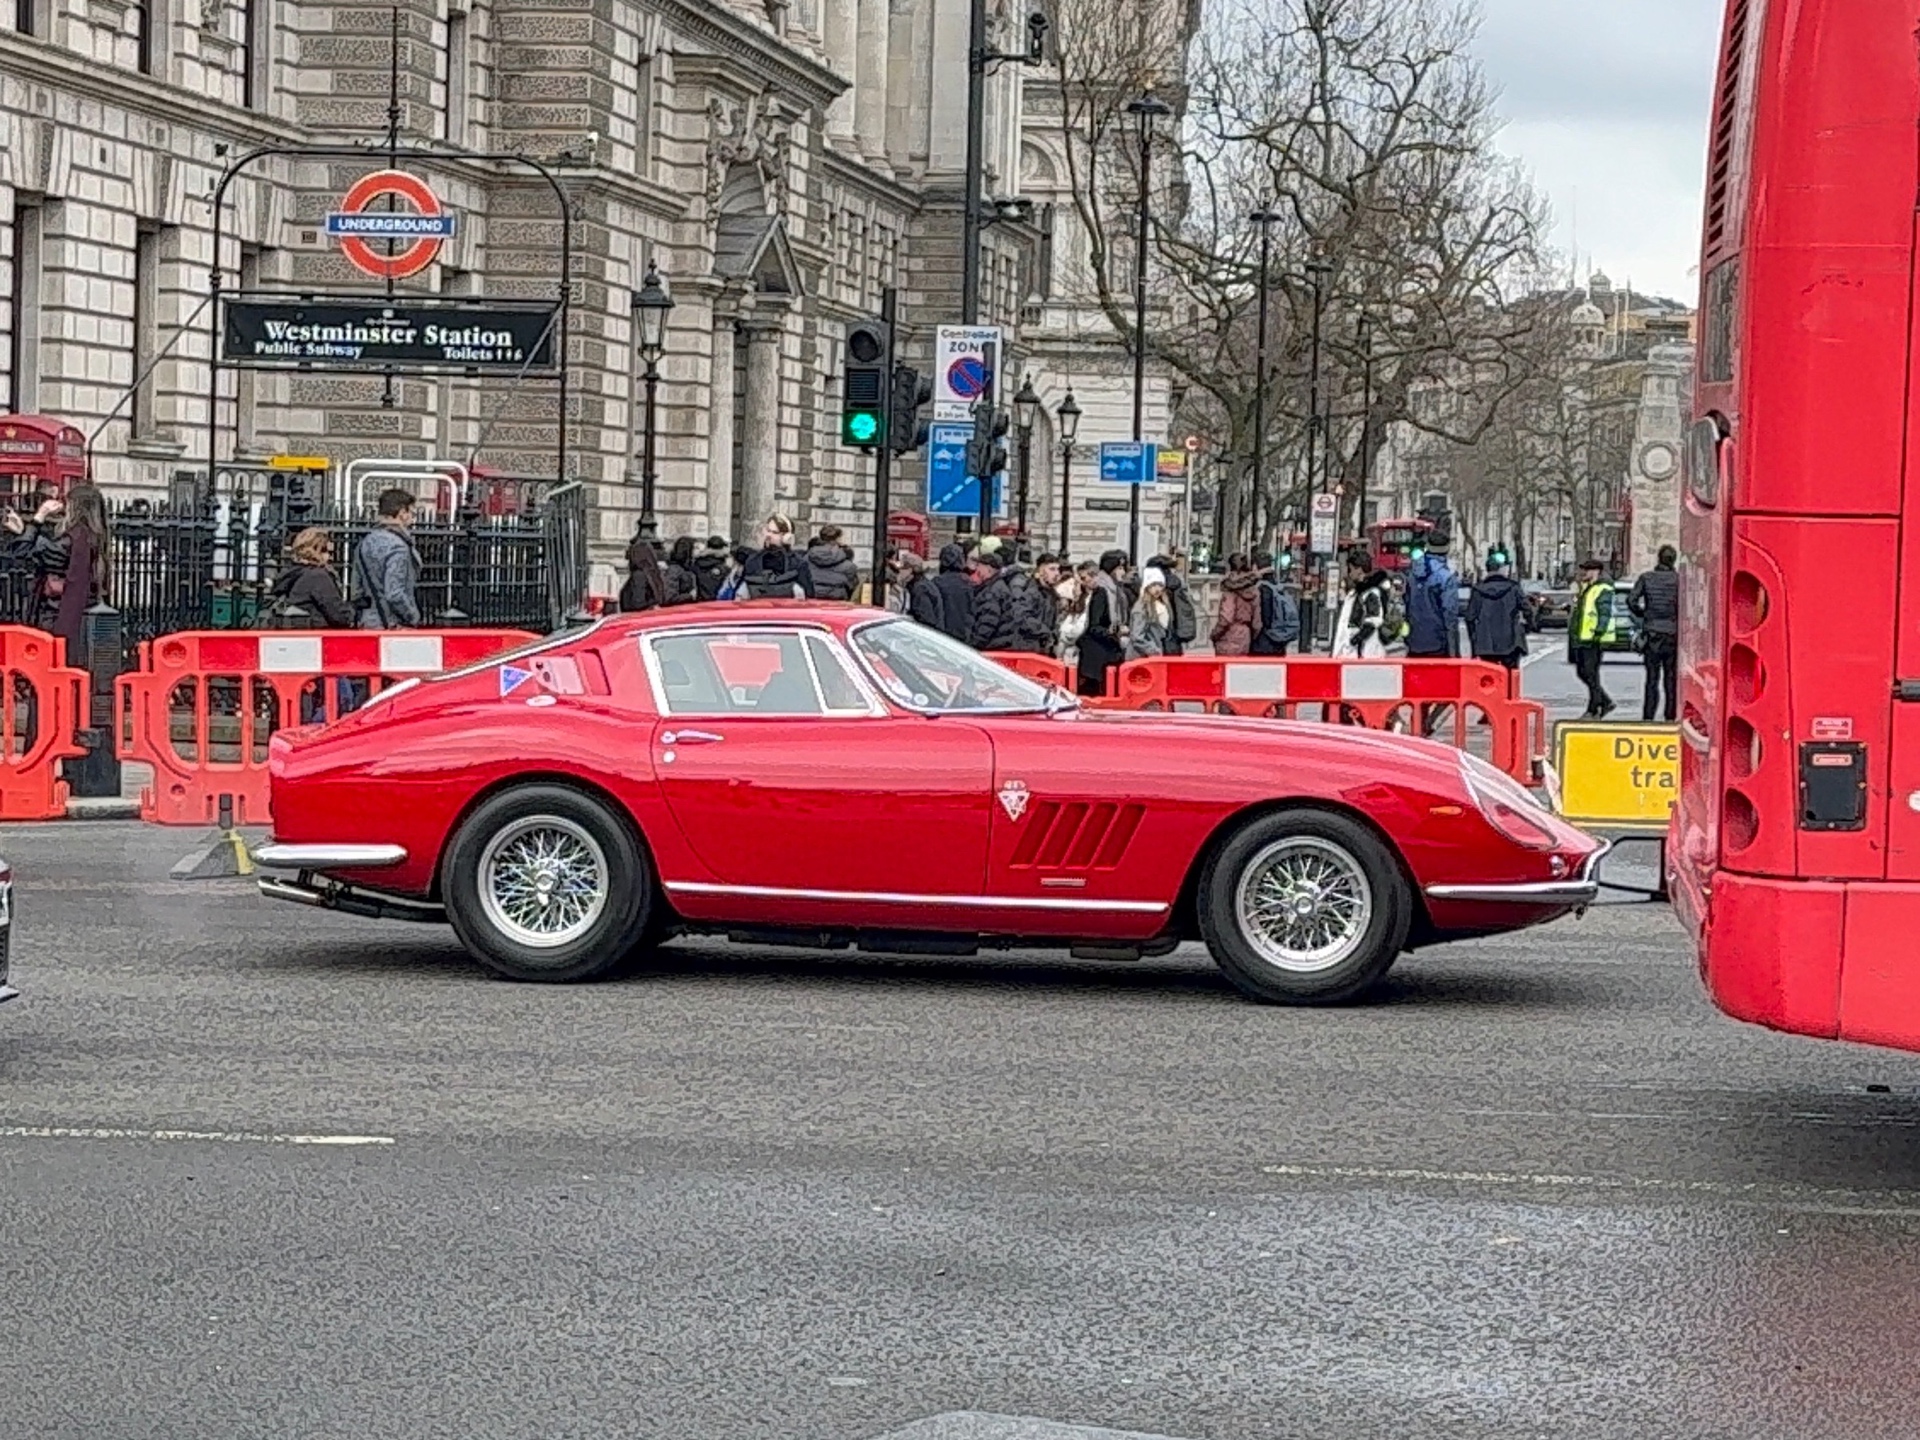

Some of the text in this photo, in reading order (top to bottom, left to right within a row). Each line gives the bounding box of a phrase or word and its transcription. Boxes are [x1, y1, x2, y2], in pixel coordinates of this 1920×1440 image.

[338, 217, 443, 232] UNDERGROUND
[264, 320, 513, 347] Westminster Station
[255, 341, 364, 359] Public Subway
[442, 346, 493, 360] Toilets
[949, 341, 980, 353] ZON
[1614, 737, 1678, 761] Dive
[1630, 764, 1676, 788] tra
